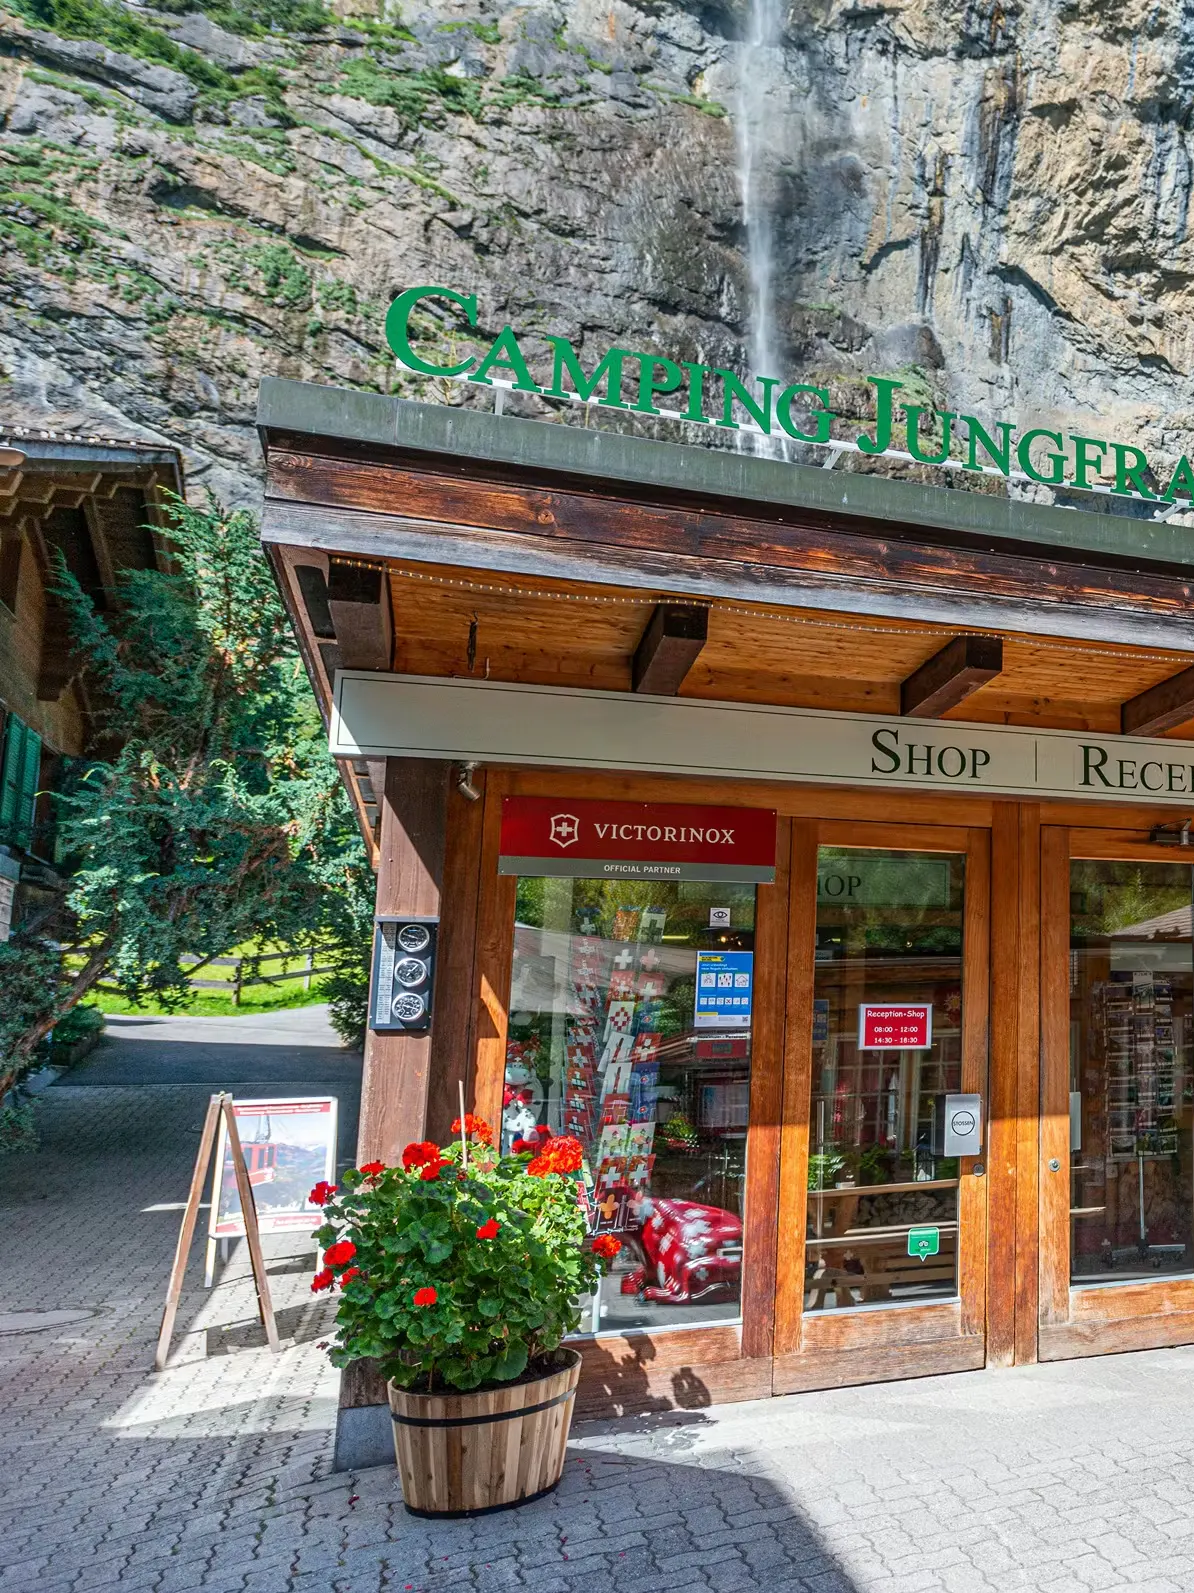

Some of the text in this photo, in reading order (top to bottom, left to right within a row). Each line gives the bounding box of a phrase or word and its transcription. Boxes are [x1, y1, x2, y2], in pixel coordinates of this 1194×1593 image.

[385, 285, 837, 444] CAMPING
[870, 728, 991, 780] SHOP
[594, 823, 735, 844] VICTORINOX
[603, 864, 681, 874] OFFICIAL PARTNER
